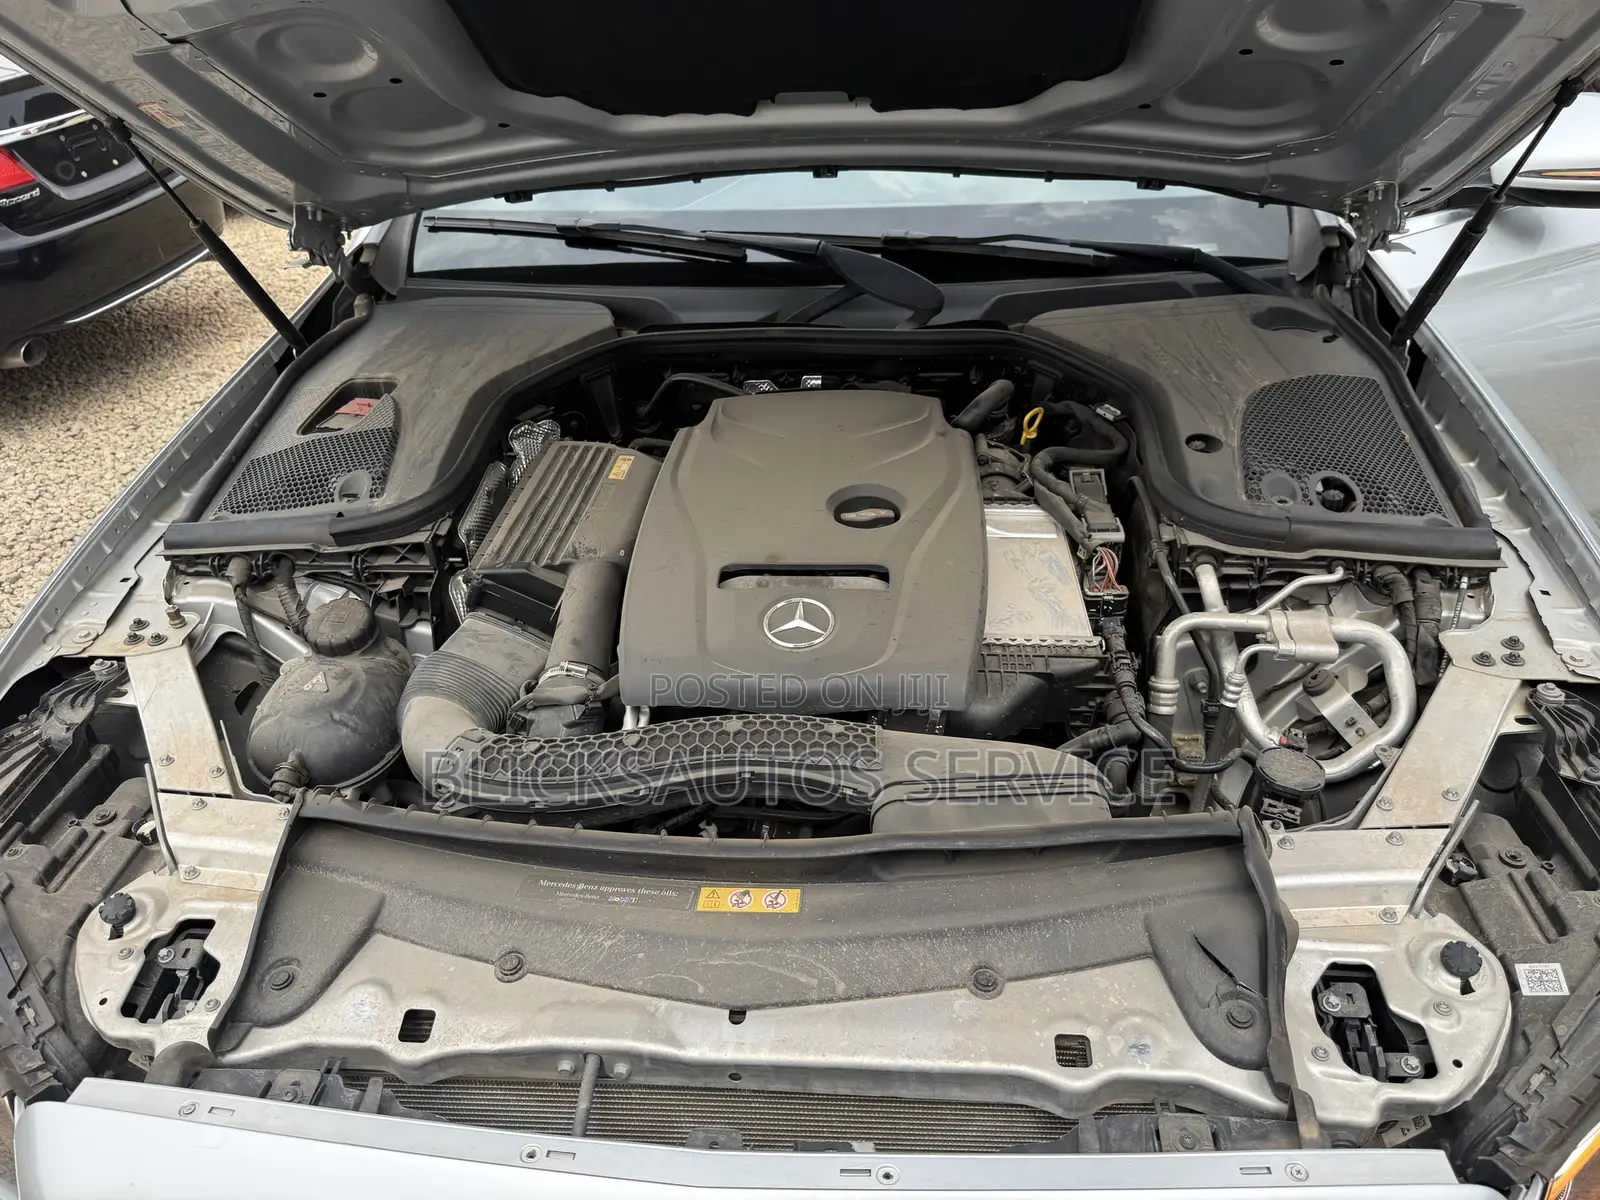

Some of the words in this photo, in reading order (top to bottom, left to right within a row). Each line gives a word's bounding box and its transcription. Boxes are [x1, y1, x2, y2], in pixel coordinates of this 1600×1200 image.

[538, 879, 598, 891] Mercedes-Benz
[599, 885, 636, 893] approves
[637, 888, 660, 896] these
